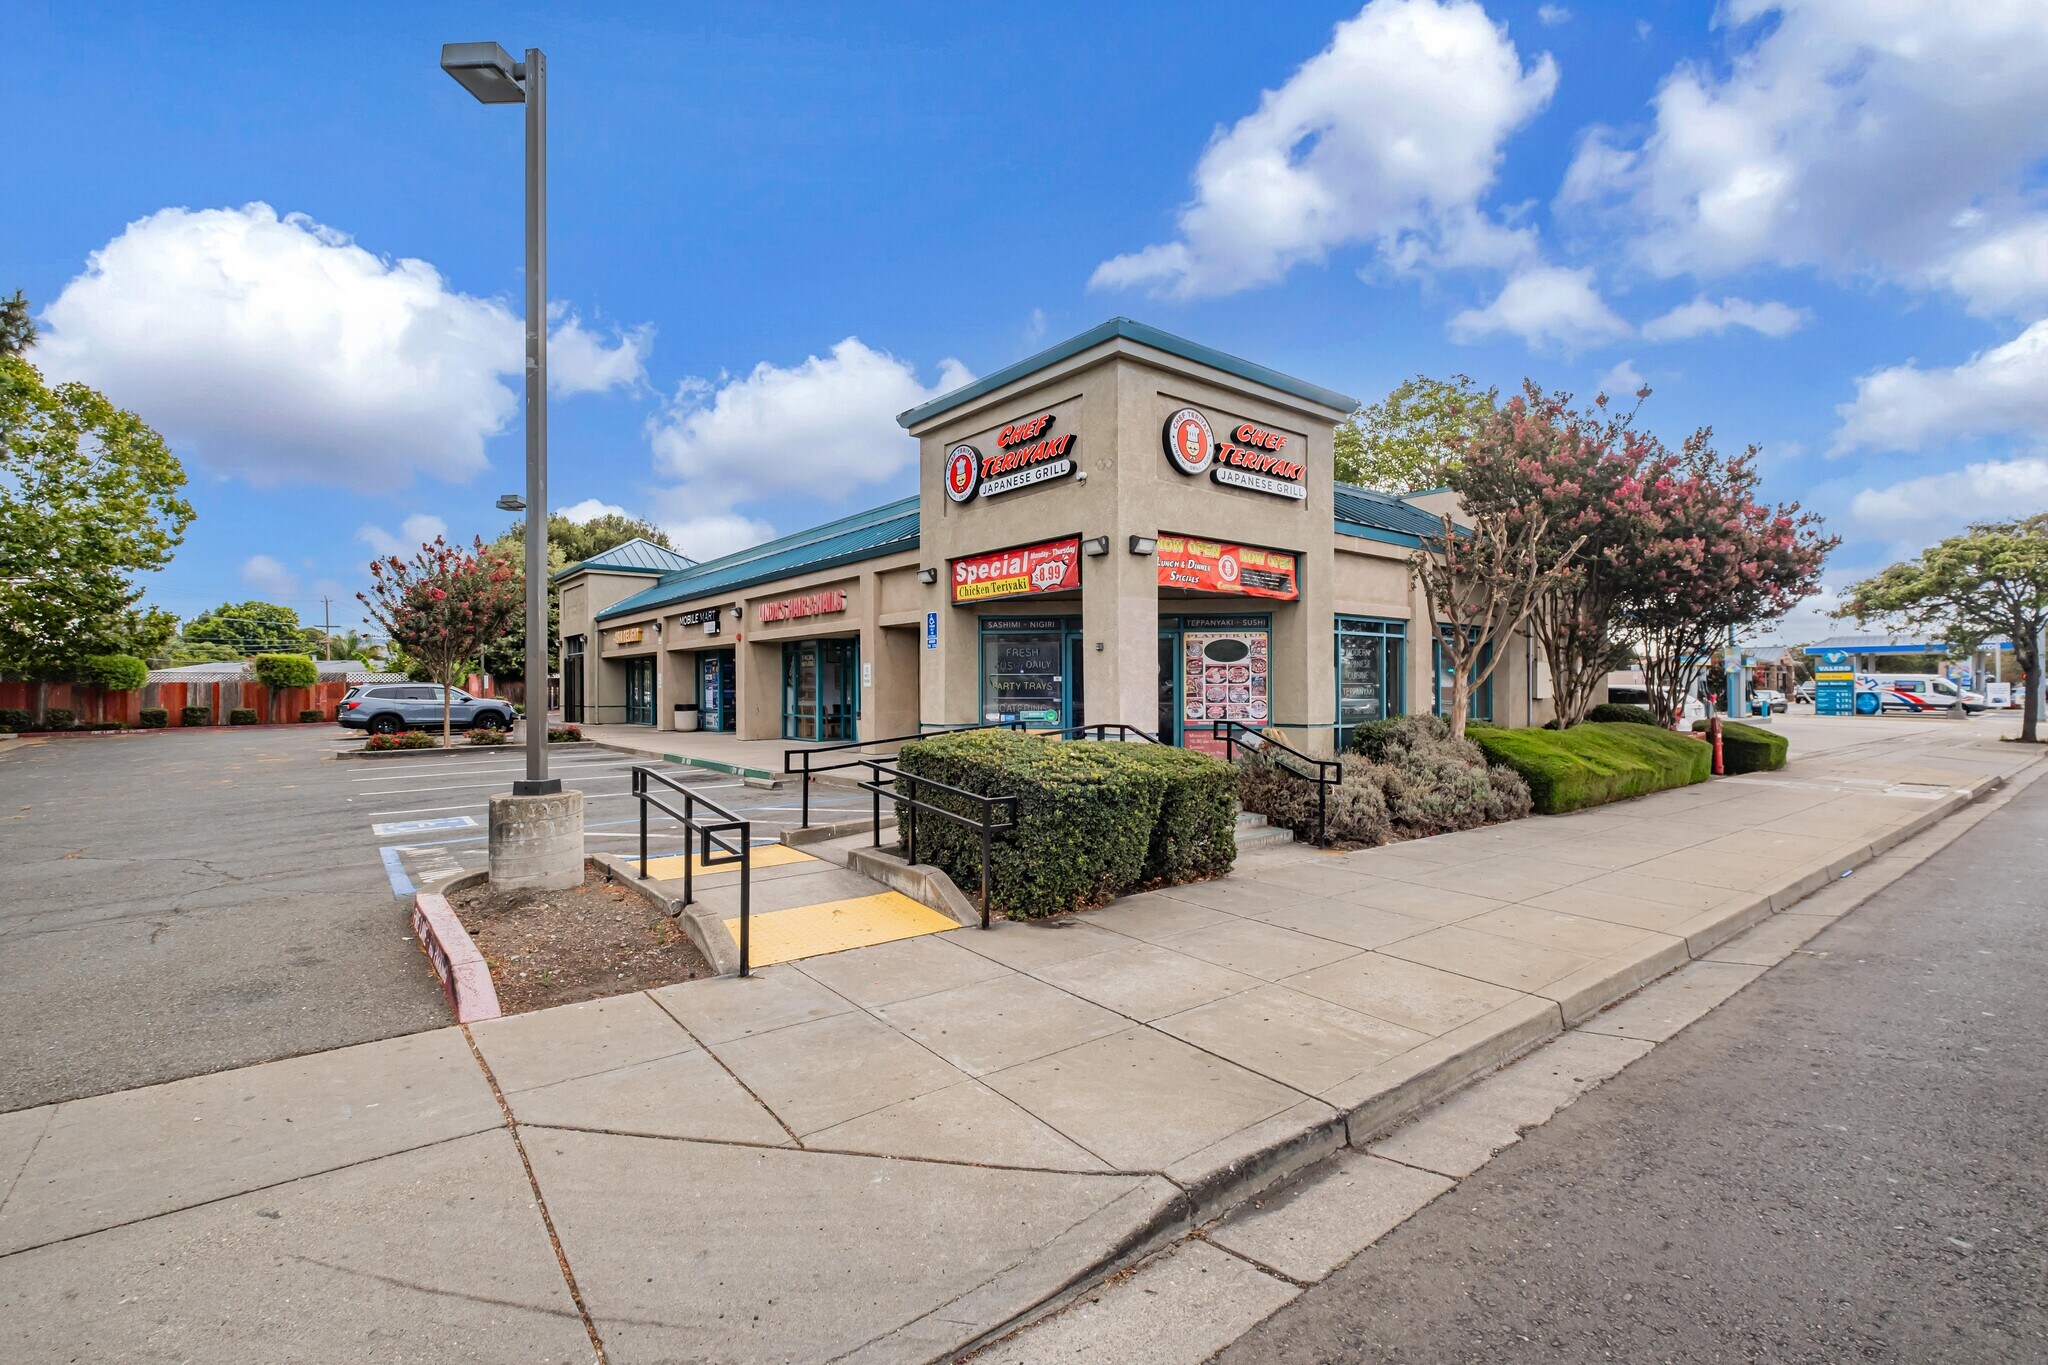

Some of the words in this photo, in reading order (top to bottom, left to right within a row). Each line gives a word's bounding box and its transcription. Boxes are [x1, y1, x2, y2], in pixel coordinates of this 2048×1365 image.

[997, 413, 1050, 449] CHEF
[1173, 412, 1185, 429] CHEF
[1187, 411, 1211, 438] TERIYAKI
[1236, 423, 1288, 451] CHEF
[980, 433, 1070, 478] TERIYAKI
[1218, 442, 1307, 480] TERIYAKI
[982, 472, 1031, 495] JAPANESE
[1035, 463, 1067, 480] GRILL
[1221, 470, 1273, 490] JAPANESE
[1276, 483, 1304, 497] GRILL
[1052, 546, 1076, 556] Thursday
[1157, 536, 1184, 553] NOW
[1187, 540, 1221, 559] OPEN
[956, 551, 1029, 584] Special
[1239, 549, 1265, 565] NOW
[1268, 554, 1293, 570] OPEN
[1034, 565, 1061, 582] $8.99
[959, 586, 990, 597] Chicken
[991, 578, 1027, 594] Teriyaki
[788, 597, 808, 618] HAIR
[816, 590, 846, 614] NAILS
[679, 611, 699, 626] MOBILE
[699, 609, 717, 624] MART
[988, 621, 1021, 629] SASHIMI
[1006, 648, 1039, 657] FRESH
[1346, 648, 1371, 656] MODERN
[1025, 660, 1052, 669] DAILY
[992, 681, 1021, 691] PARTY
[1024, 681, 1053, 691] TRAYS
[1347, 671, 1369, 680] CUISINE
